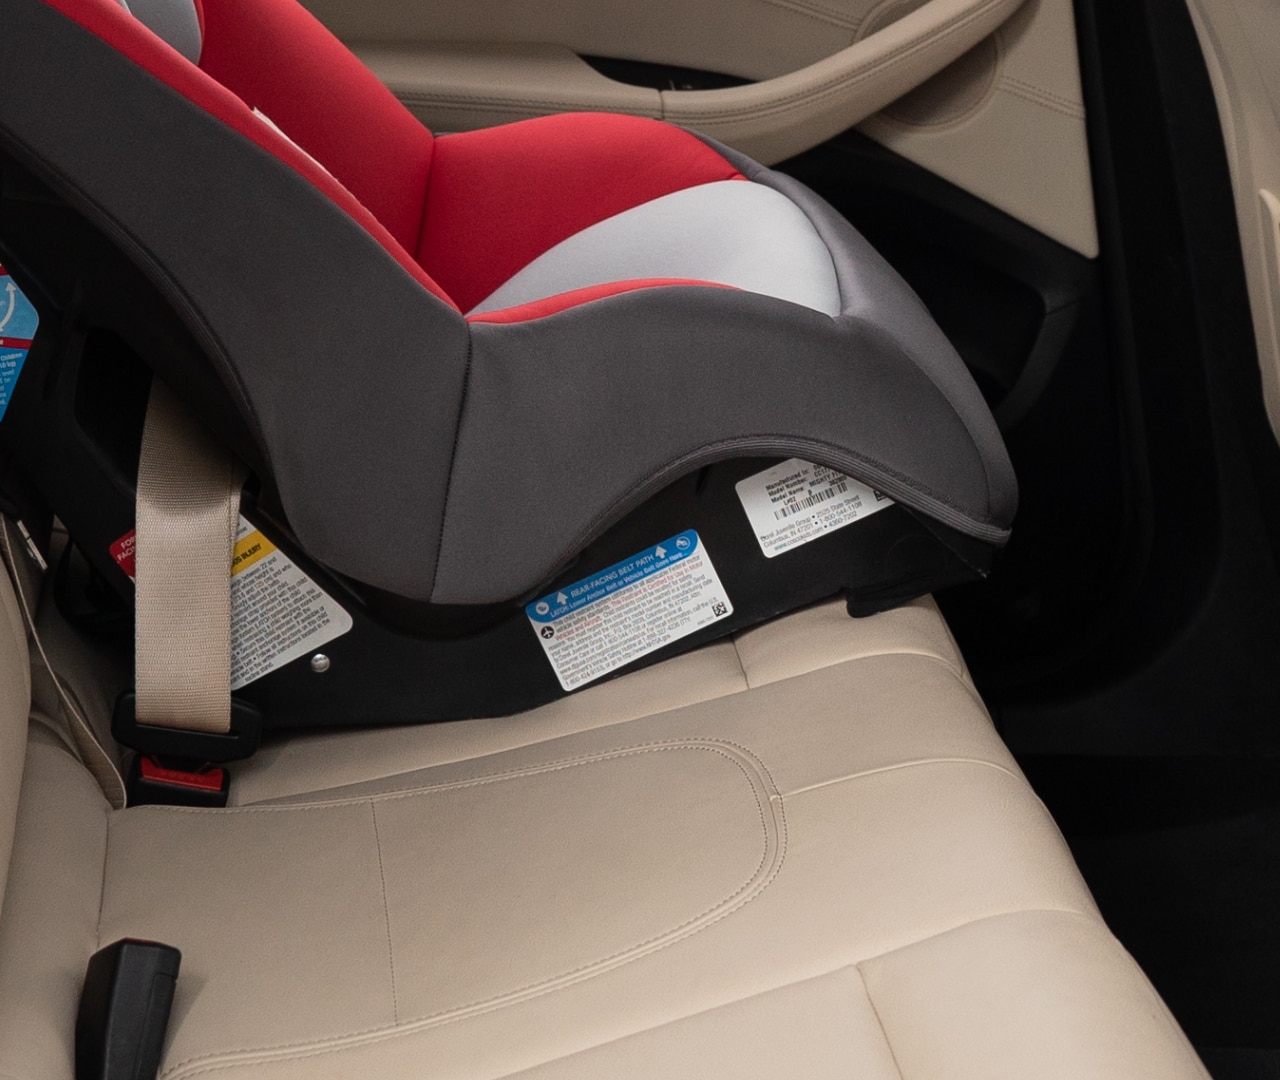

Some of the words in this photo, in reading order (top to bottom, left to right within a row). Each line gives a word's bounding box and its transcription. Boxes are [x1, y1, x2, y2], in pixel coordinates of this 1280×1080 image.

[765, 471, 801, 491] Manufactured
[768, 486, 784, 497] Model
[770, 492, 787, 503] Model
[775, 522, 795, 535] Juvenile
[794, 515, 811, 527] Group
[843, 493, 860, 505] Street
[763, 532, 790, 549] Columbus,
[796, 522, 813, 533] 47201
[818, 500, 862, 524] 1-800-544-1108
[240, 543, 262, 559] INJURY
[569, 569, 618, 598] REAR-FACING
[617, 562, 635, 576] BELT
[634, 553, 654, 568] PATH
[568, 596, 586, 609] Lower
[585, 586, 605, 600] Anchor
[623, 569, 643, 583] Vehicle
[315, 611, 328, 622] child
